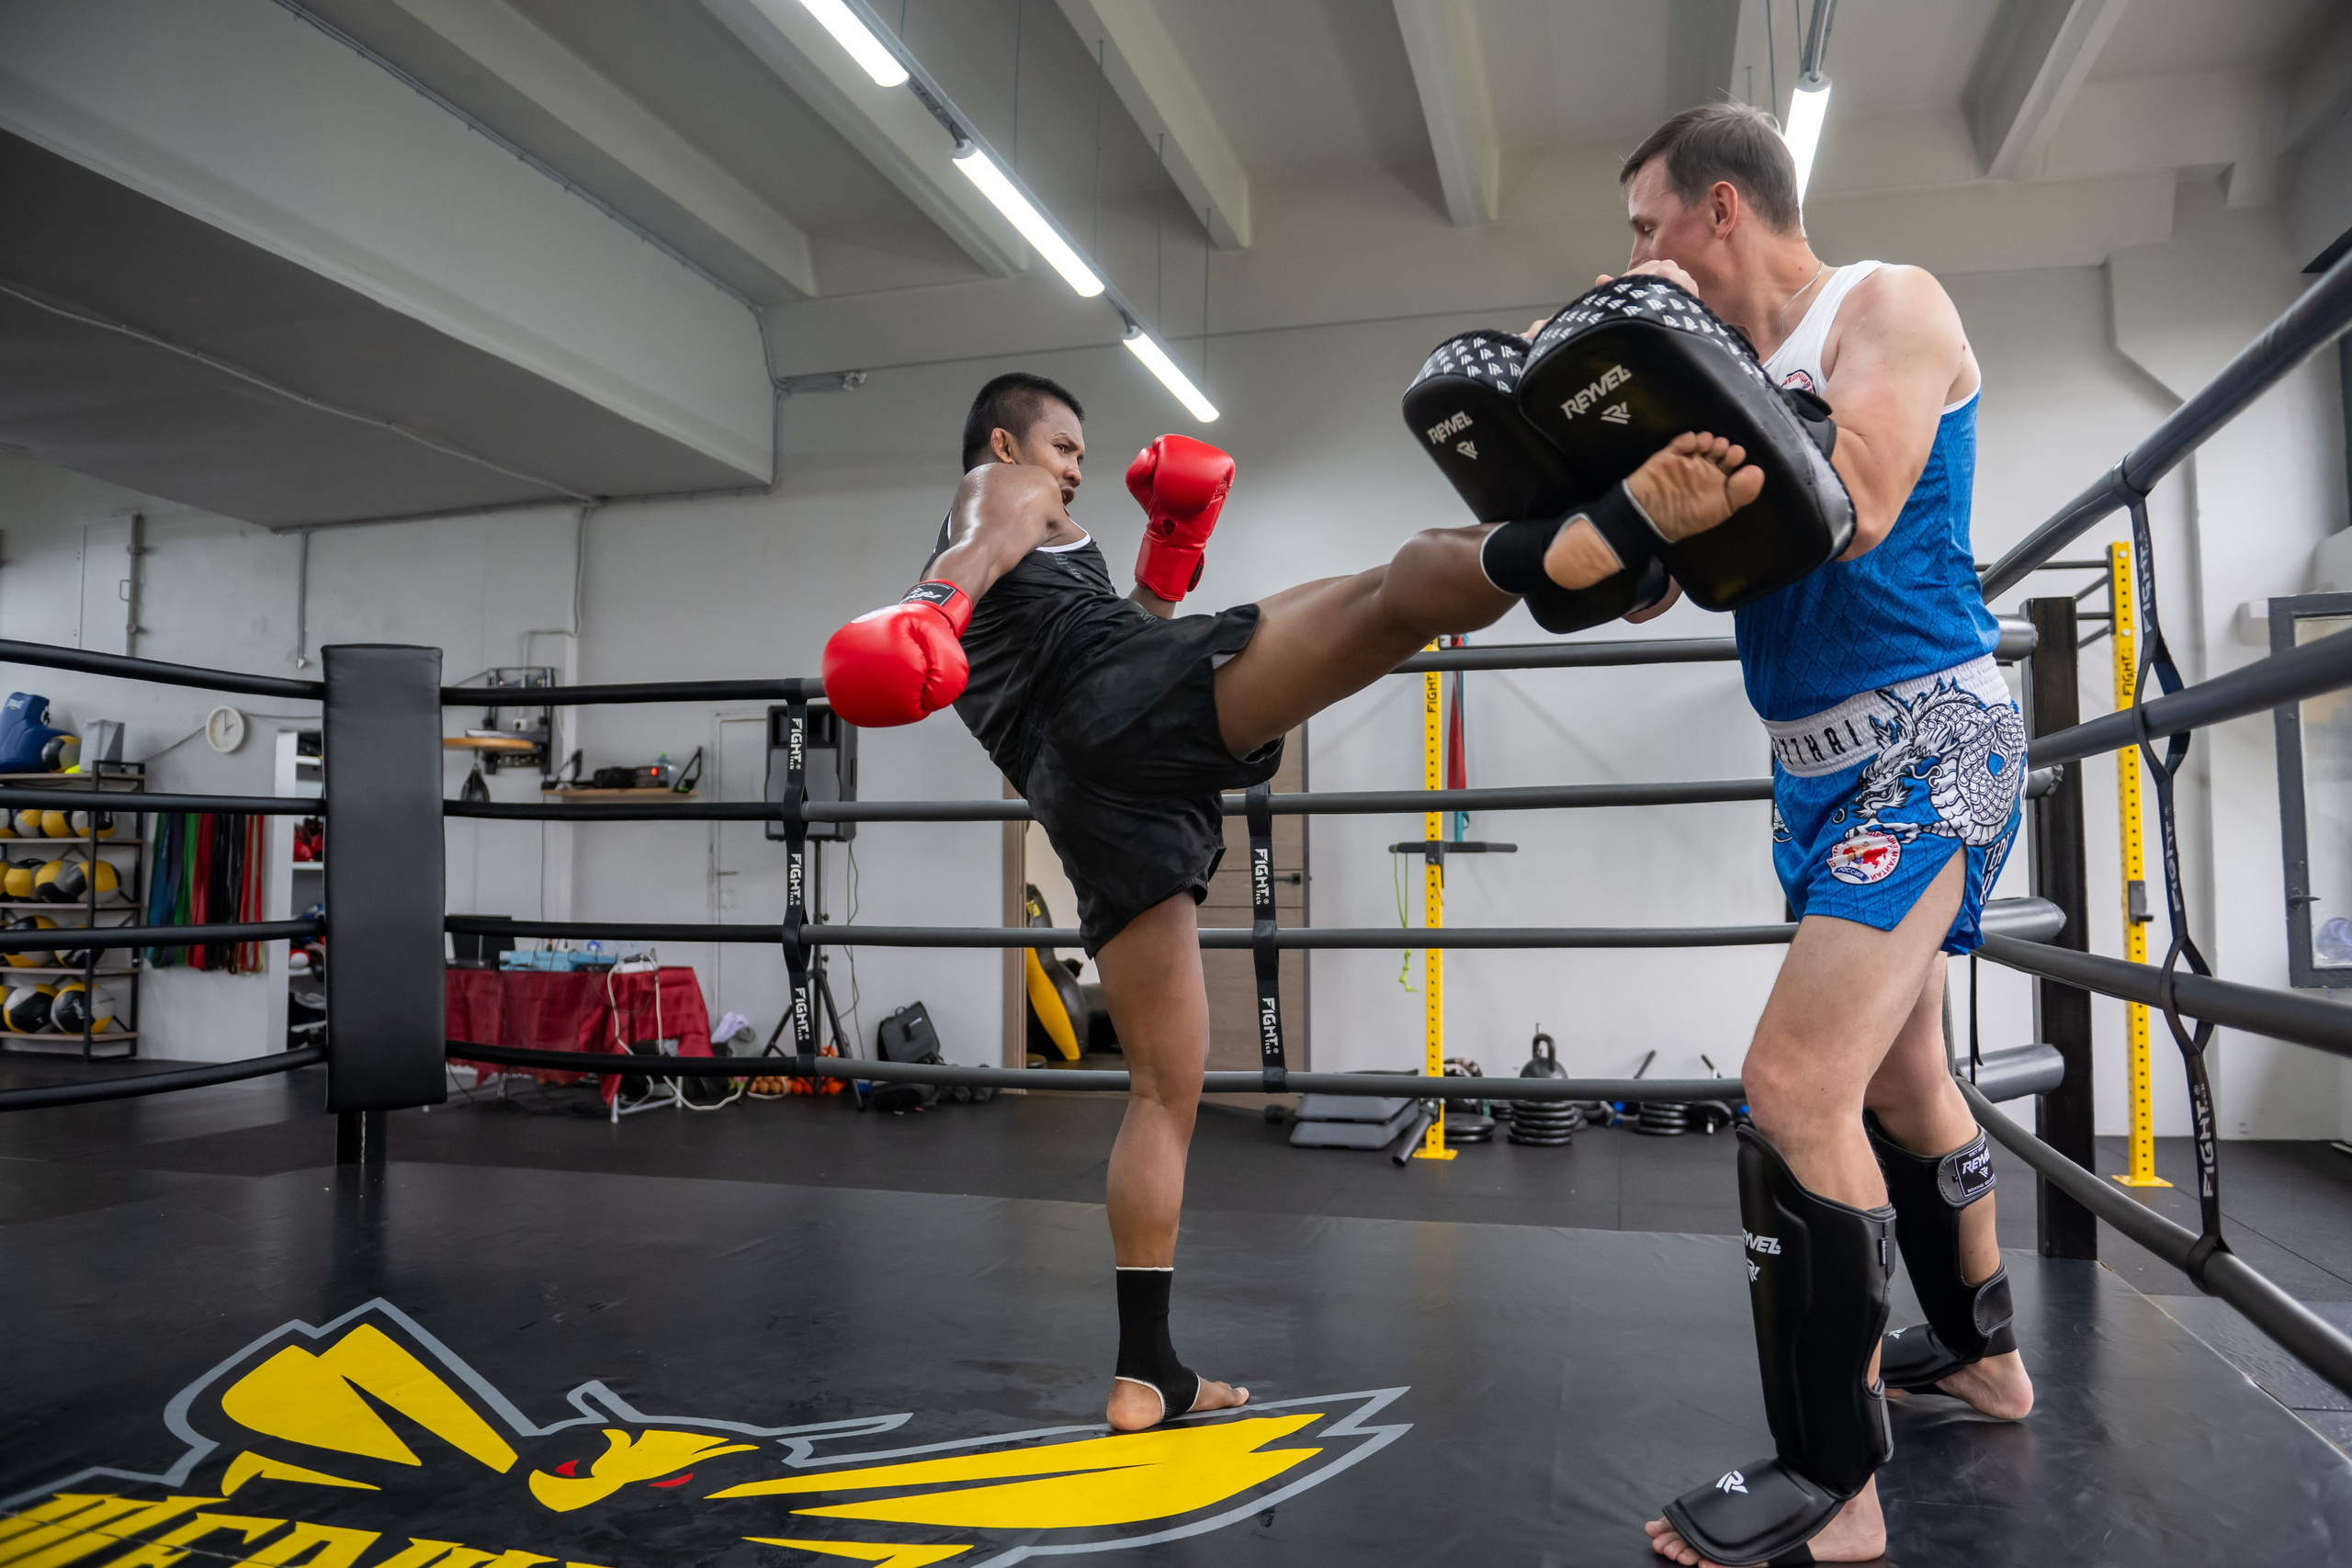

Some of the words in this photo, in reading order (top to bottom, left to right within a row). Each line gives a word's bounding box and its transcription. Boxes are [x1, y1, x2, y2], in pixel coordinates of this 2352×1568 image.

[1560, 364, 1632, 420] REYVEL
[1426, 410, 1474, 445] REYVEL
[2139, 546, 2153, 634] FIGHT
[1427, 674, 1437, 713] FIGHT
[2121, 655, 2133, 696] FIGHT
[791, 717, 803, 762] FIGHT
[790, 853, 802, 898] FIGHT
[1254, 848, 1270, 897] FIGHT
[2165, 821, 2182, 912] FIGHT
[794, 987, 809, 1032] FIGHT
[1261, 997, 1278, 1046] FIGHT
[1962, 1147, 1991, 1175] REYVE
[2196, 1100, 2215, 1197] FIGHT
[1742, 1227, 1781, 1255] YVEL
